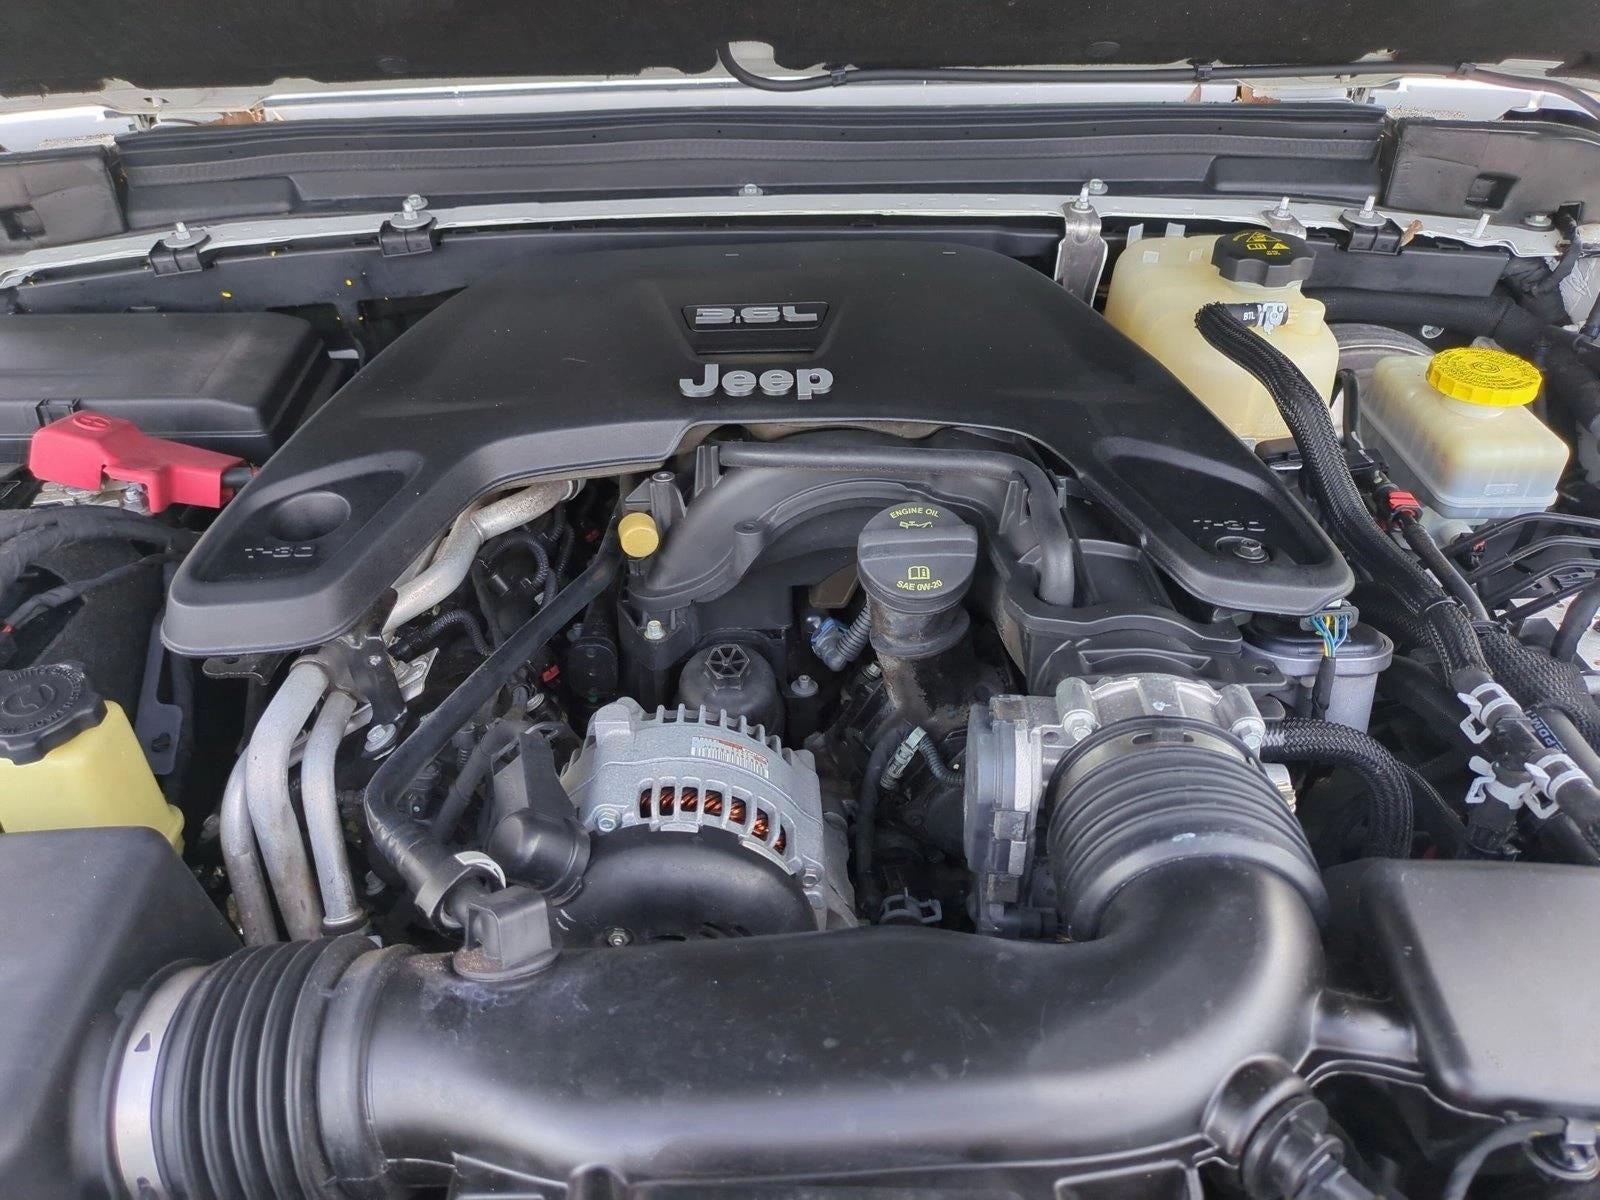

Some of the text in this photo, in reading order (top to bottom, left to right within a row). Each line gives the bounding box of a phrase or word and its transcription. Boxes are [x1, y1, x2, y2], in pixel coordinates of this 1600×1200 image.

[695, 305, 818, 324] 3.6L
[679, 364, 834, 400] Jeep
[890, 507, 940, 519] ENGINE OIL
[896, 580, 943, 591] SAE 0W-20
